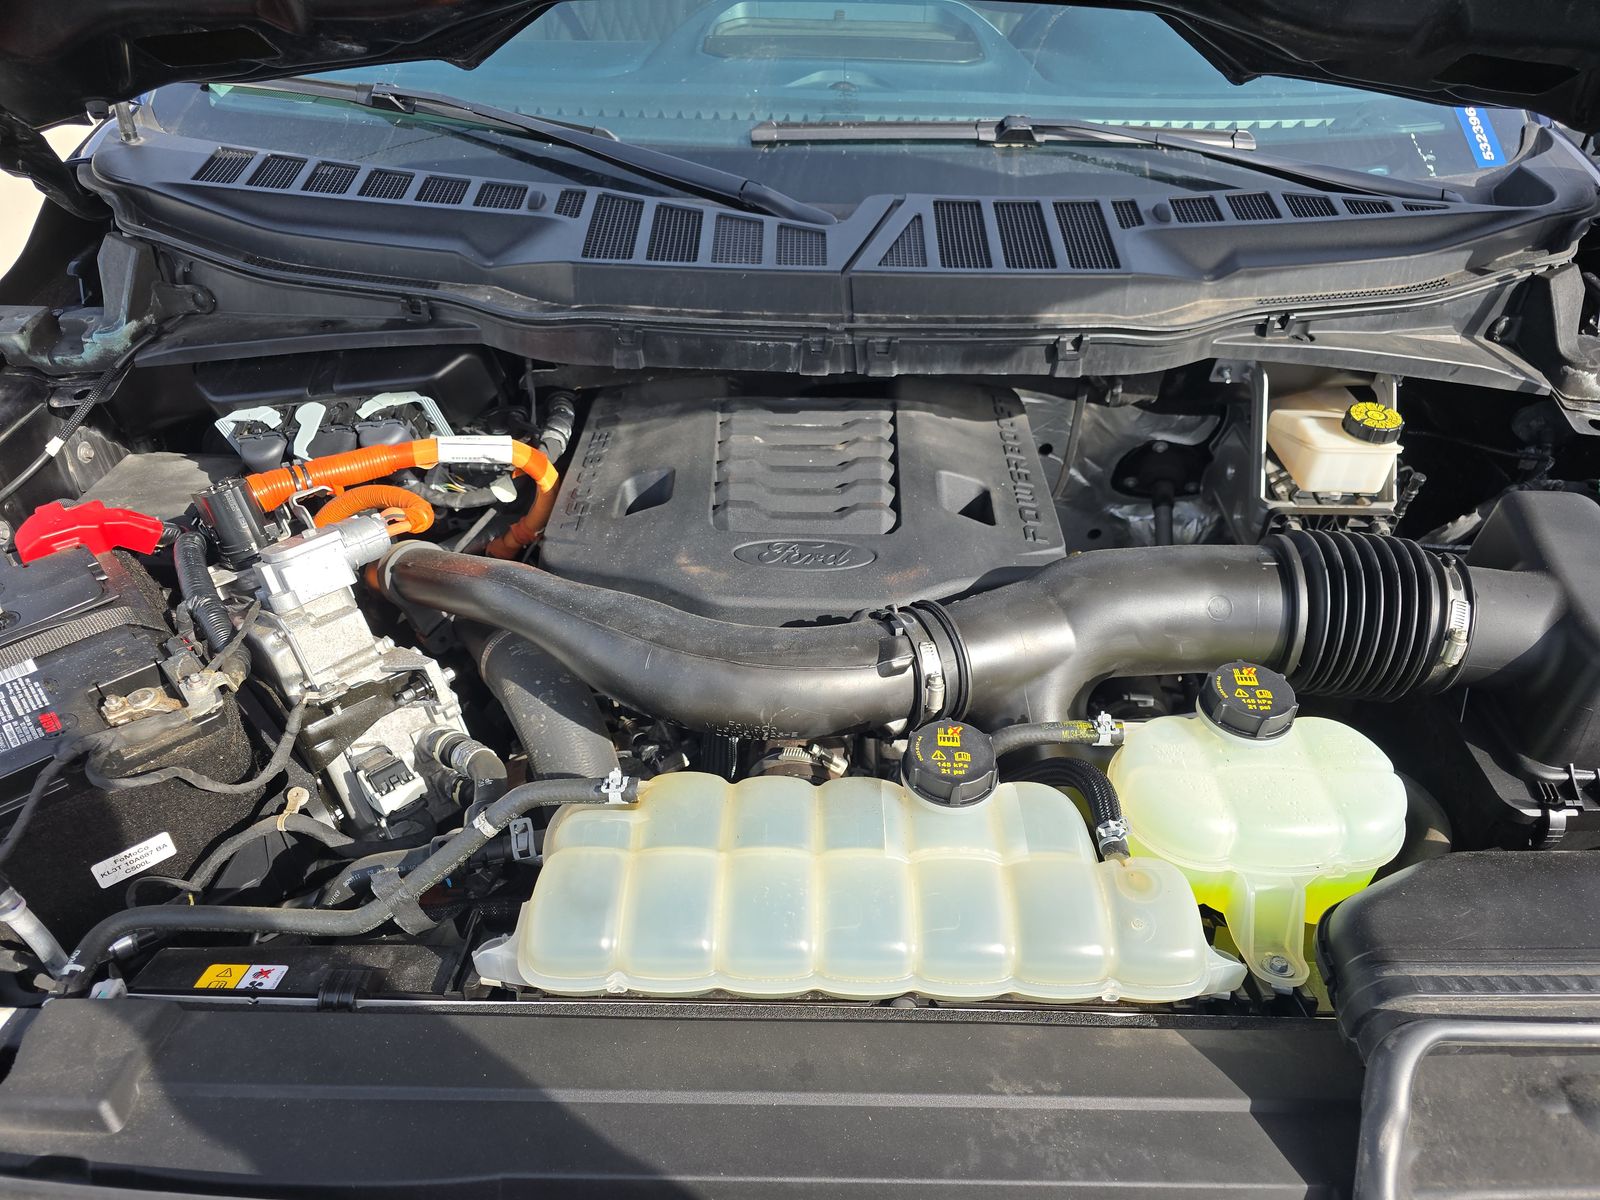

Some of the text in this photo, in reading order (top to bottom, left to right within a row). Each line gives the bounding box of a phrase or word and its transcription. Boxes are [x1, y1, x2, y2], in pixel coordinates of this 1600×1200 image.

[992, 392, 1050, 545] POWERBOOST
[757, 542, 852, 566] Ford
[113, 845, 149, 865] FoMoCo
[100, 865, 122, 879] KL3T
